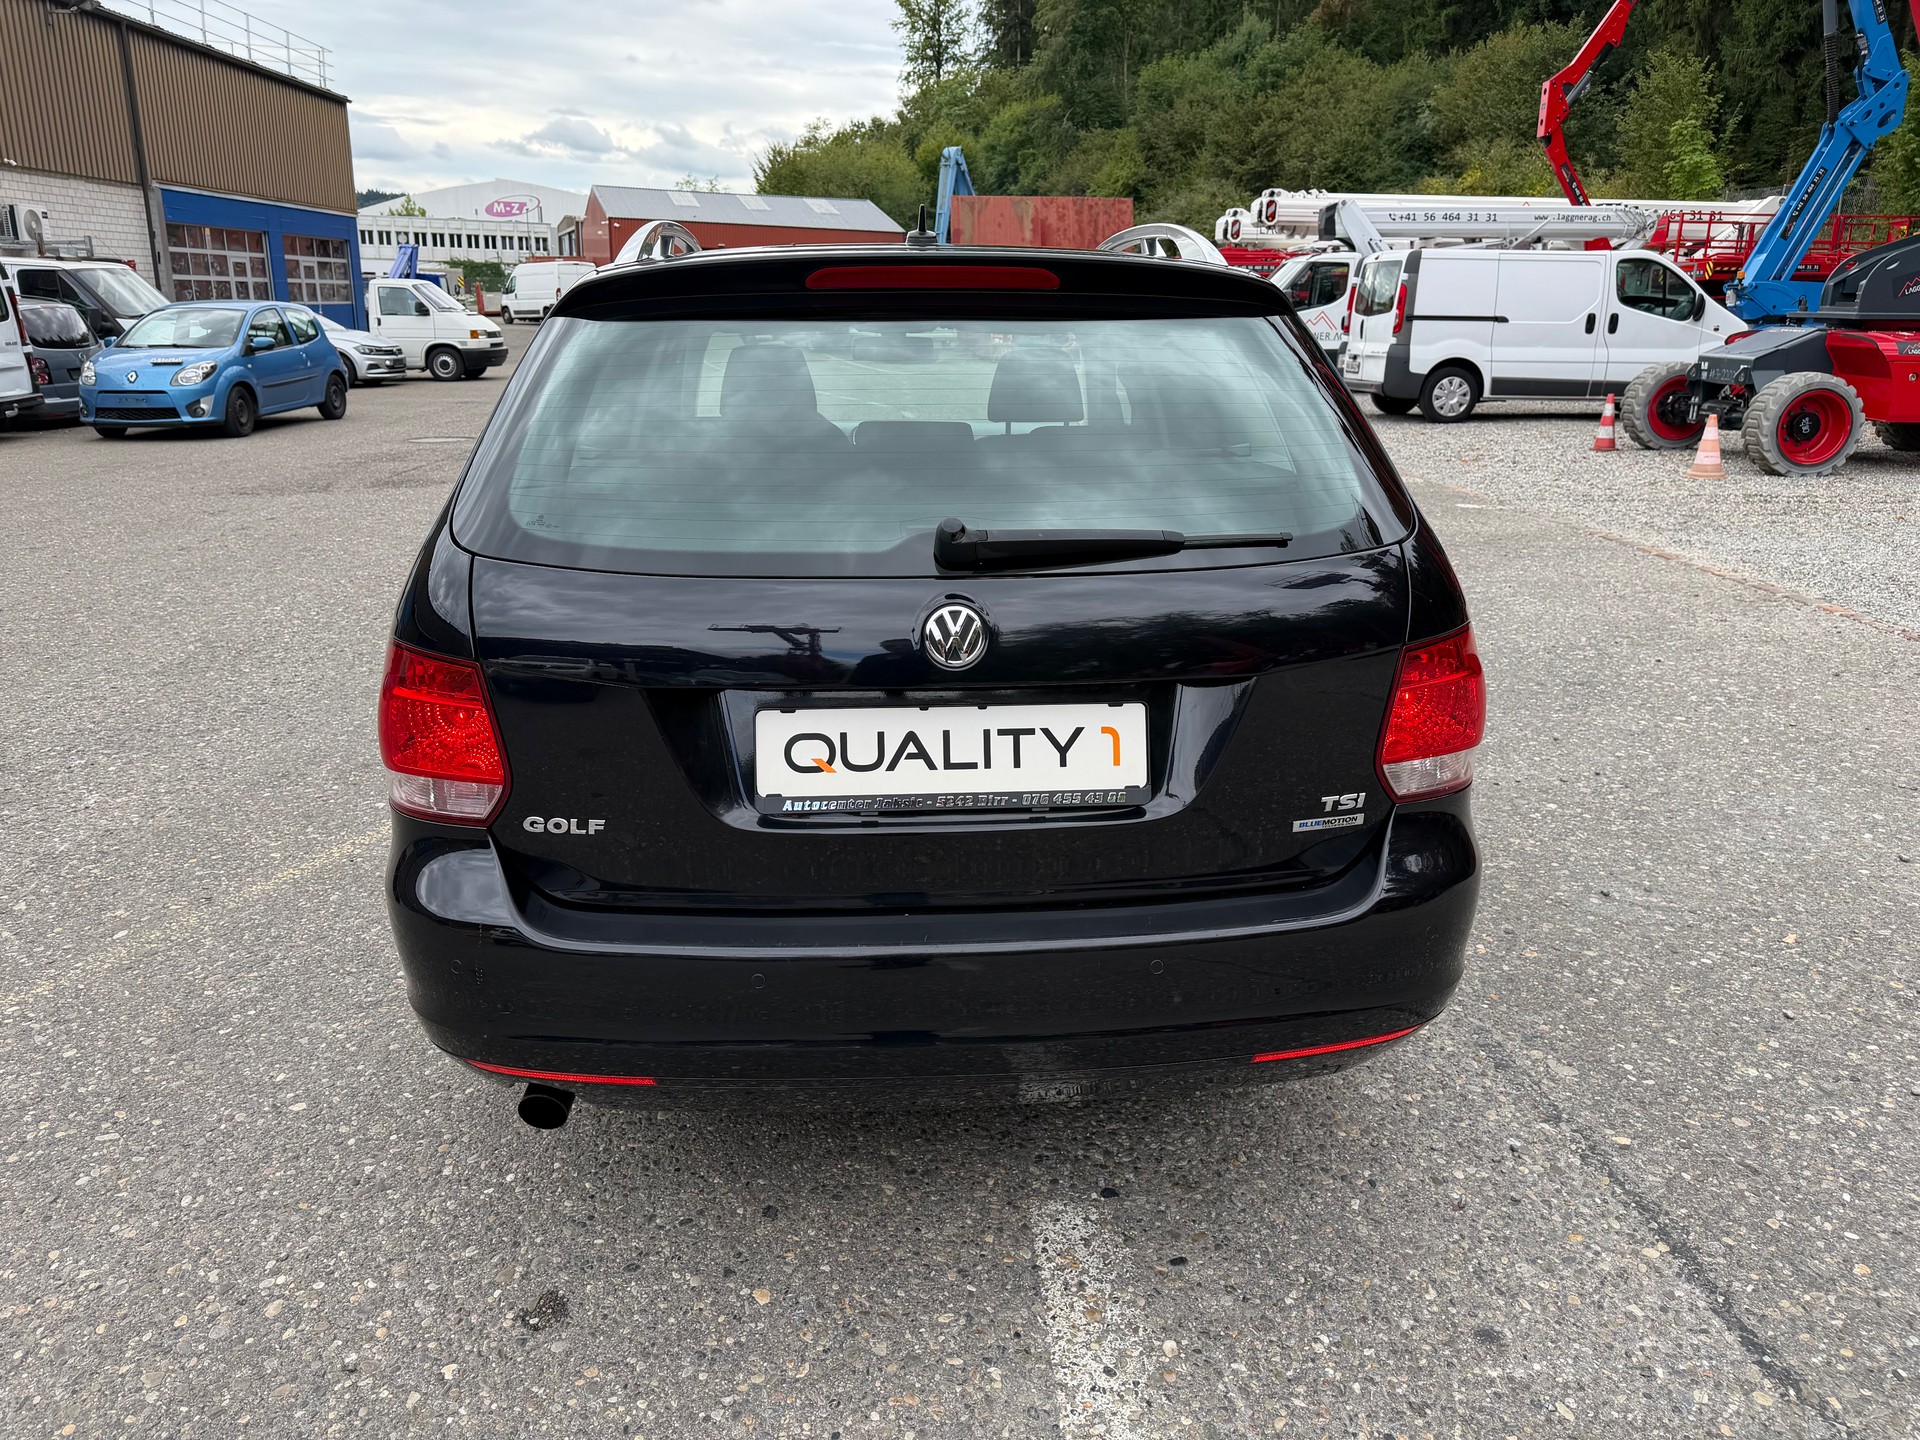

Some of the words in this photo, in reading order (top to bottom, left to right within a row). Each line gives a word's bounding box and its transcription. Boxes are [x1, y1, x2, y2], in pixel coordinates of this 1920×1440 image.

[1398, 213, 1417, 221] +41
[1423, 213, 1436, 221] 56
[1441, 213, 1460, 221] 464
[1467, 213, 1479, 221] 31
[1485, 213, 1497, 222] 31
[784, 726, 1085, 774] QUALITY
[1100, 726, 1121, 767] 1
[782, 799, 872, 811] Autocenter
[936, 795, 974, 807] 5242
[1052, 793, 1081, 804] 455
[1084, 792, 1104, 803] 43
[1321, 792, 1366, 812] TSI
[522, 816, 606, 835] GOLF
[1298, 815, 1358, 828] BLUEMOTION
